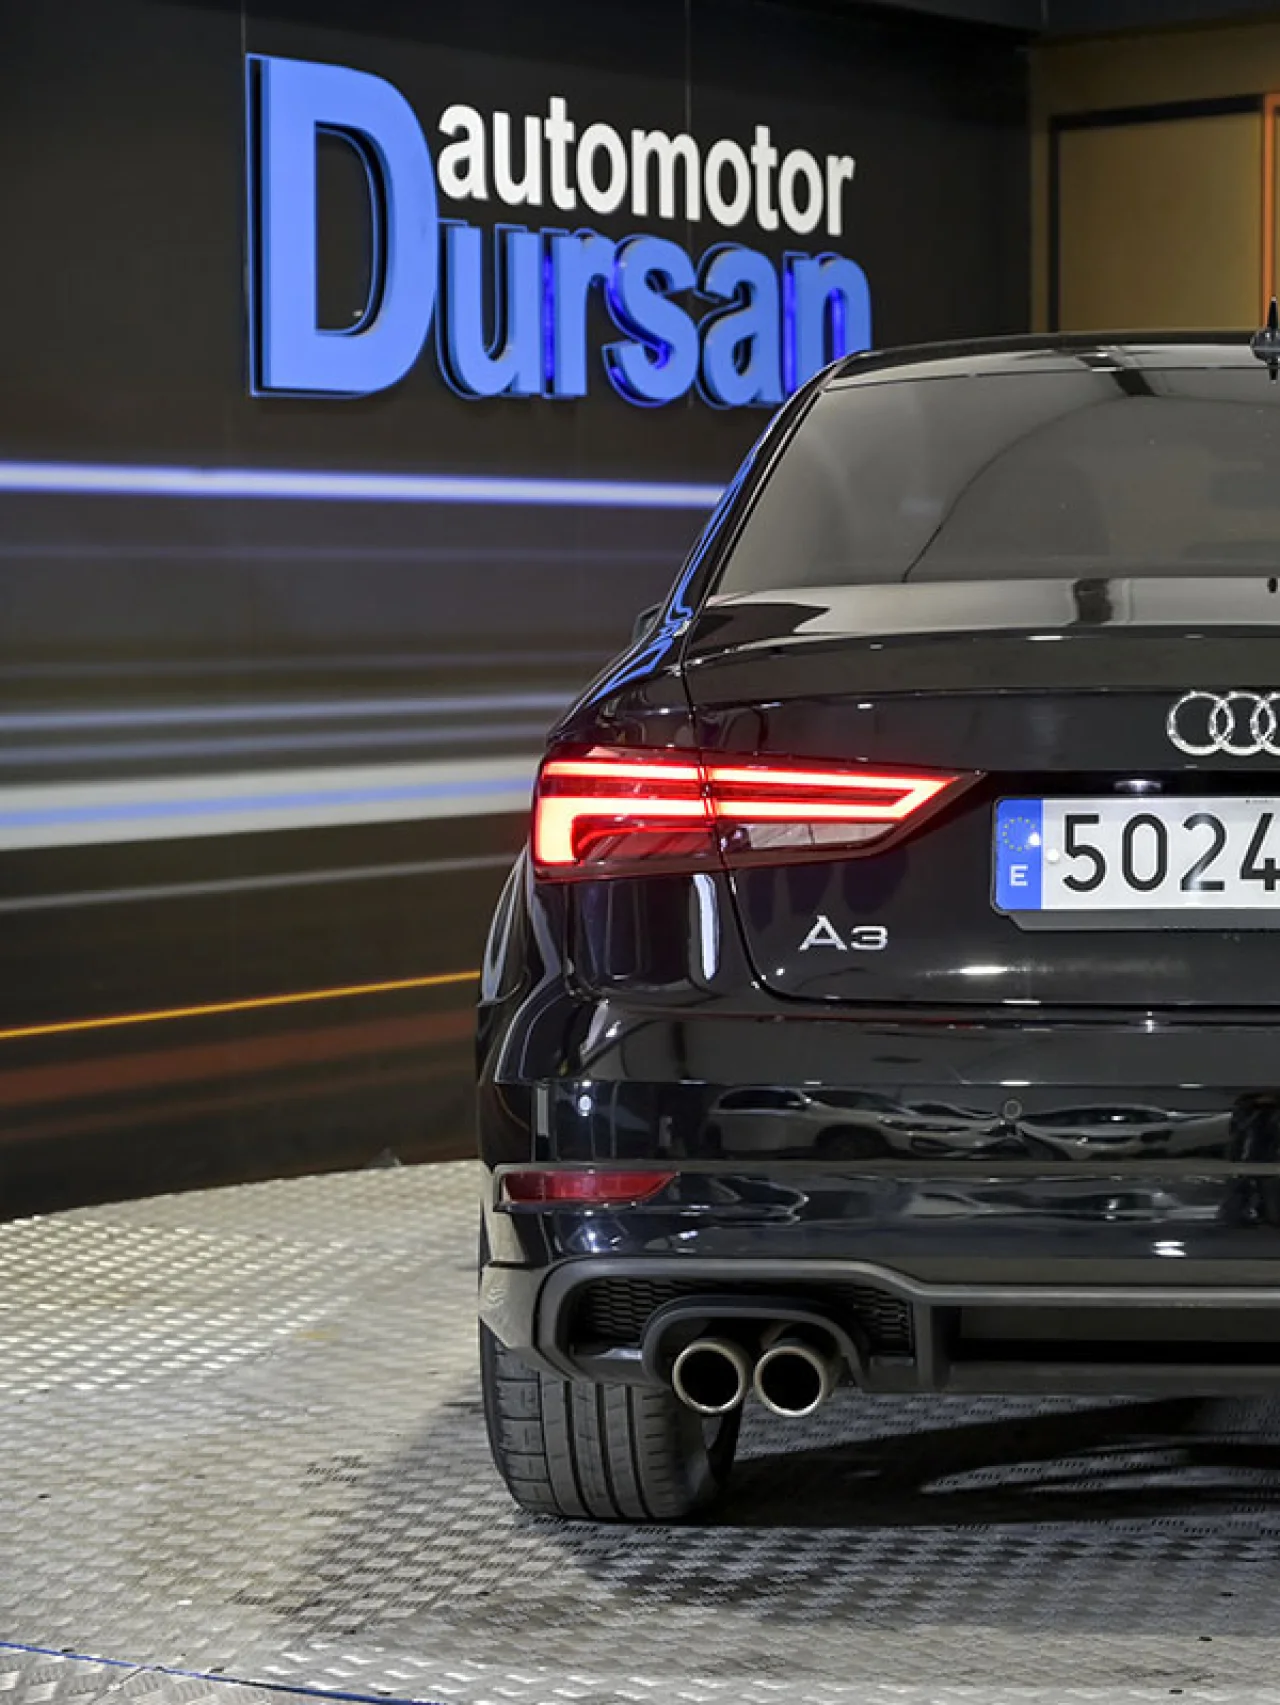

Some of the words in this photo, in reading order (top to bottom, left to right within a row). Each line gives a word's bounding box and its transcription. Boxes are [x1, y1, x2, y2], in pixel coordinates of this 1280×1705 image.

[437, 97, 855, 236] automotor
[246, 53, 872, 407] Dursan
[1010, 866, 1028, 886] E
[799, 914, 888, 951] A3
